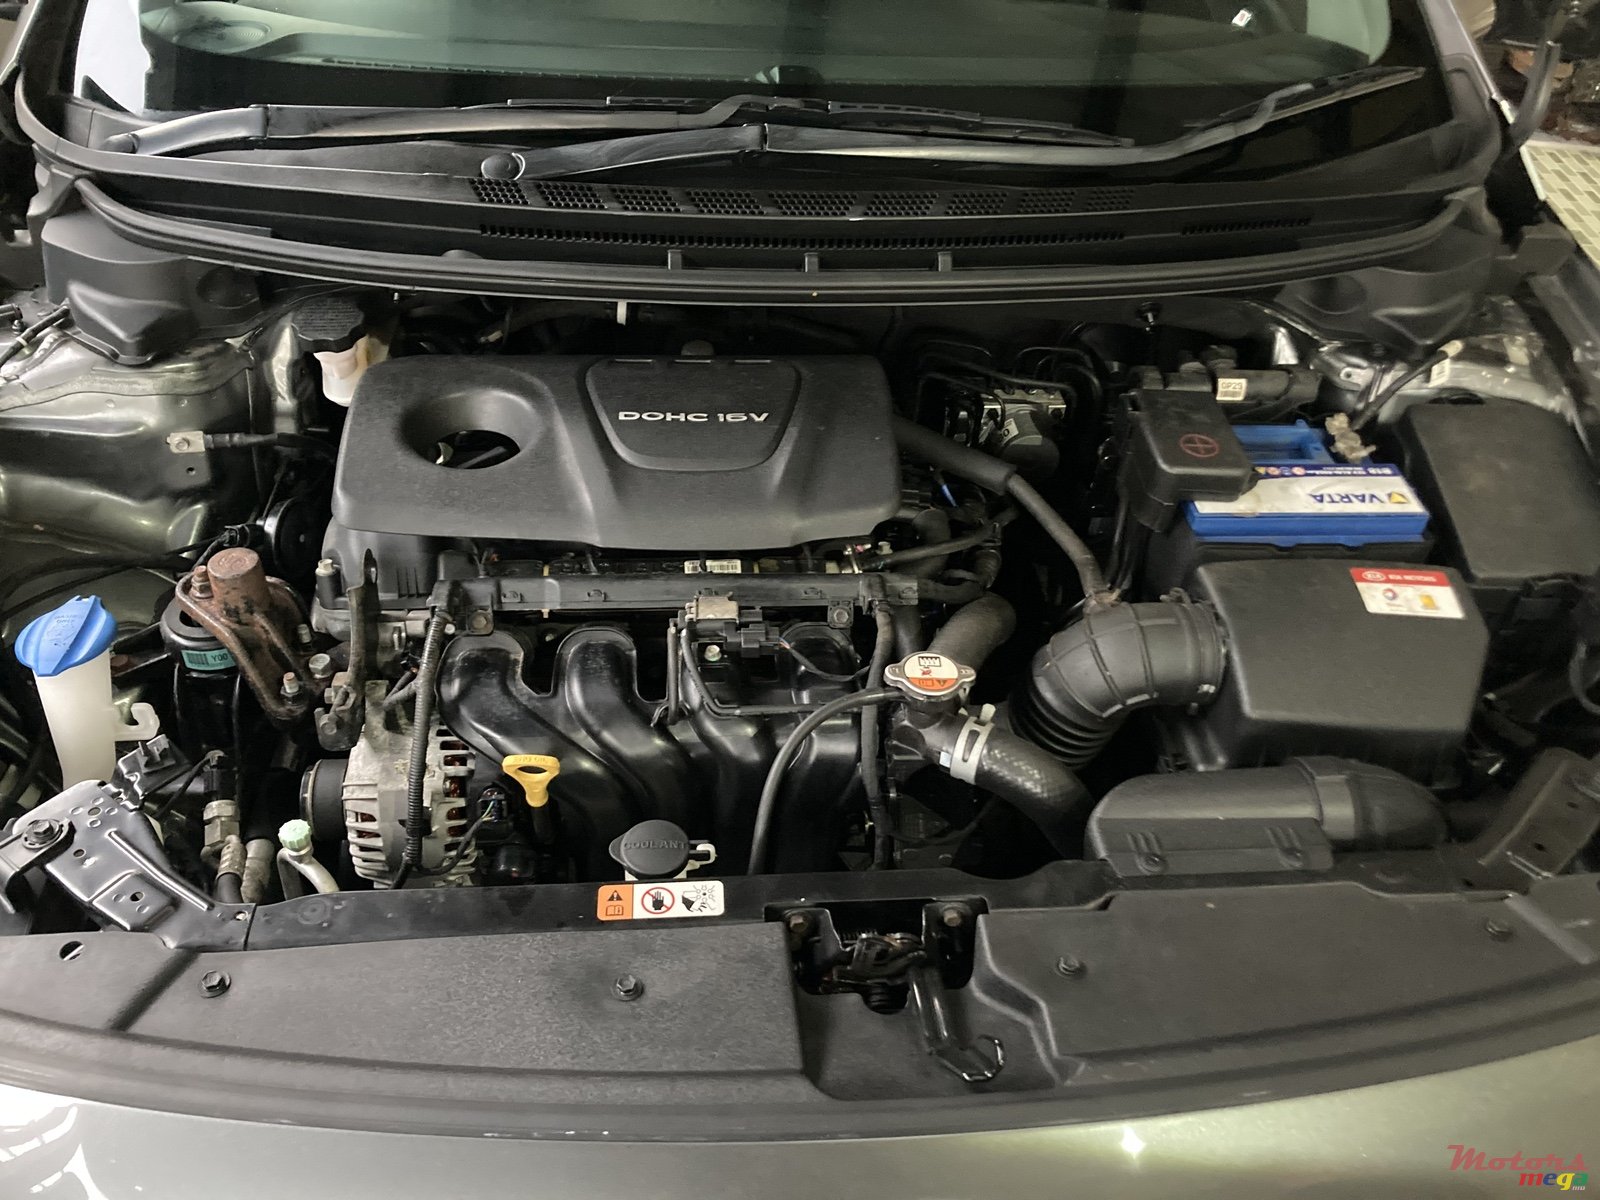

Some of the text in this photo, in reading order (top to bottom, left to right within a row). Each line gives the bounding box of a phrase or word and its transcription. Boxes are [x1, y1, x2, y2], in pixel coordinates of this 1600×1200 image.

[618, 411, 769, 422] DOHC 16V
[1308, 493, 1385, 504] VARTA
[623, 840, 687, 850] COOLANT
